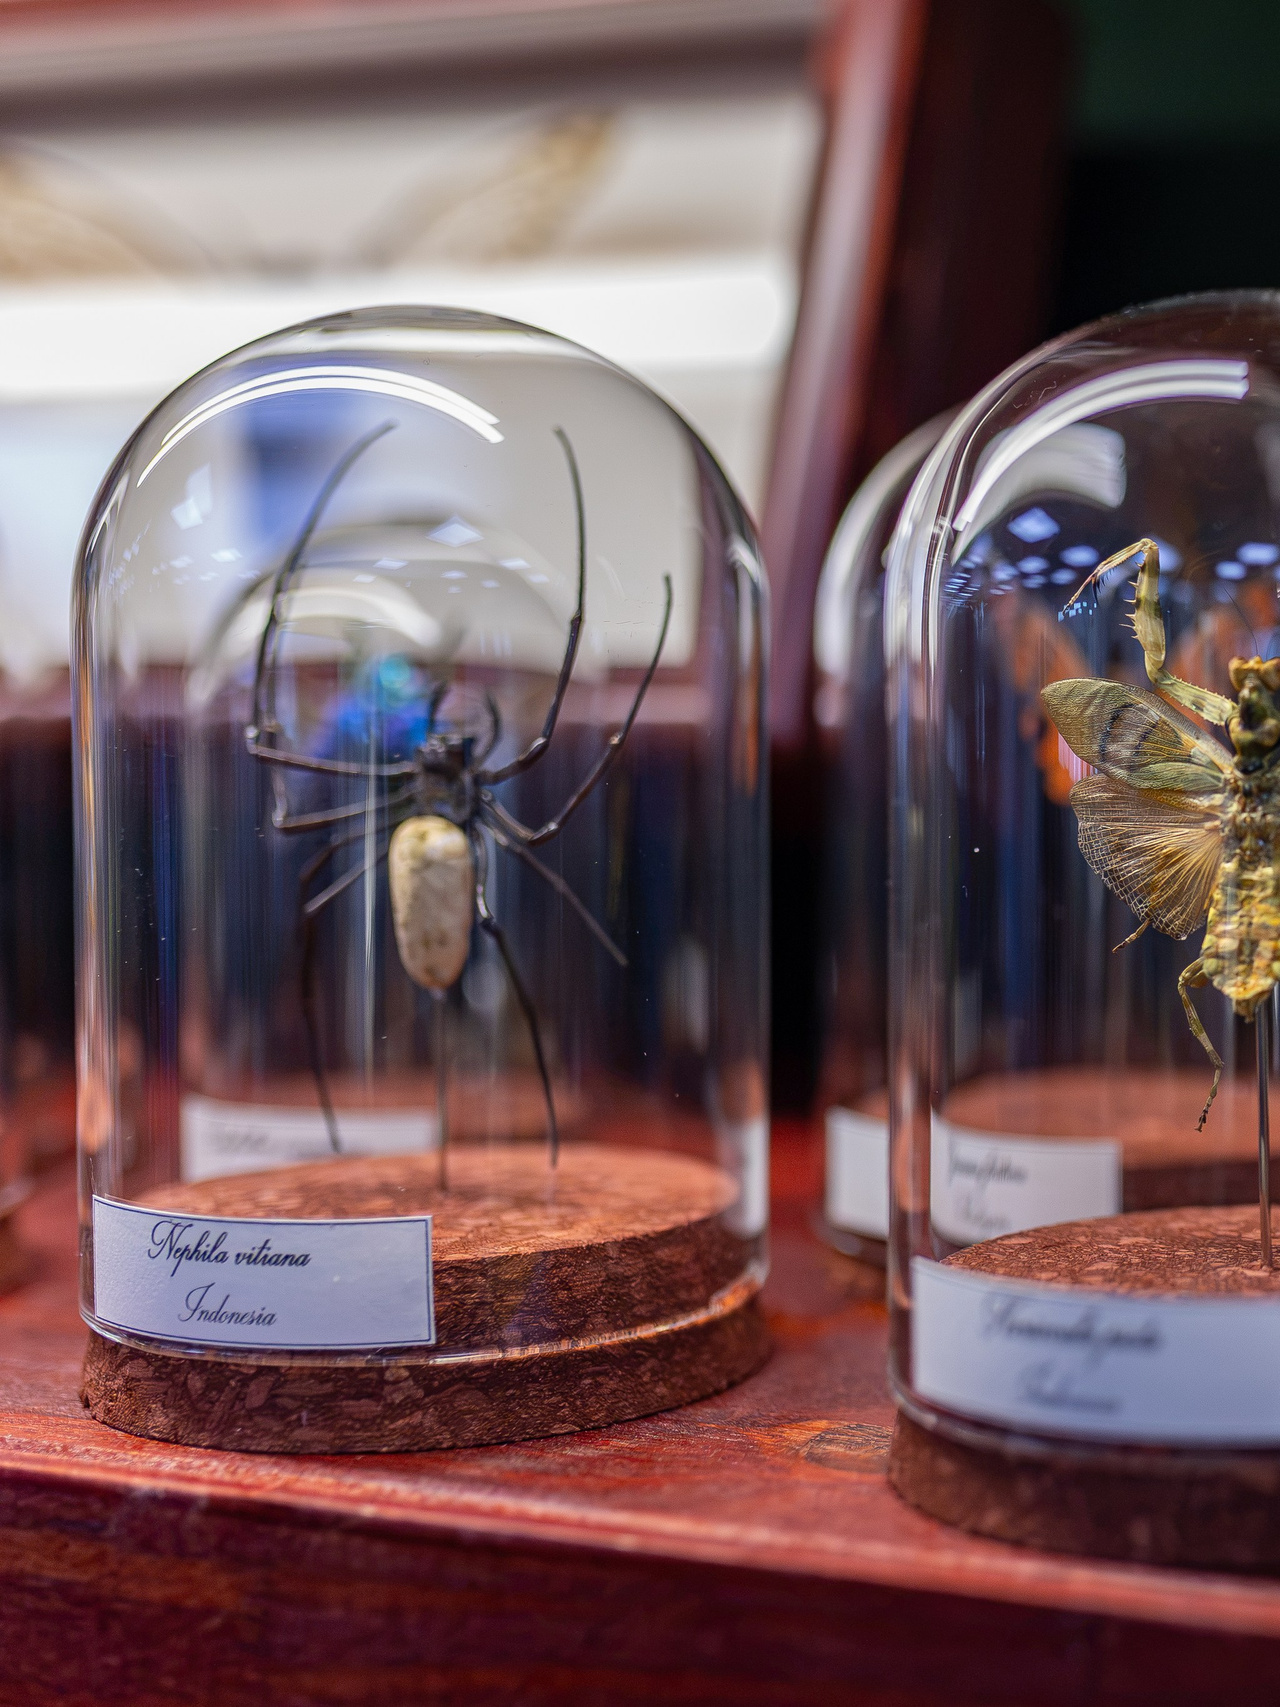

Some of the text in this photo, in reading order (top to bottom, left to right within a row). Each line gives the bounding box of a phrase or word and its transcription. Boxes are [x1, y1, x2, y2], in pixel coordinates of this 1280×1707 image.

[148, 1220, 312, 1277] Nephila vitiana
[178, 1282, 277, 1327] Indonesia
